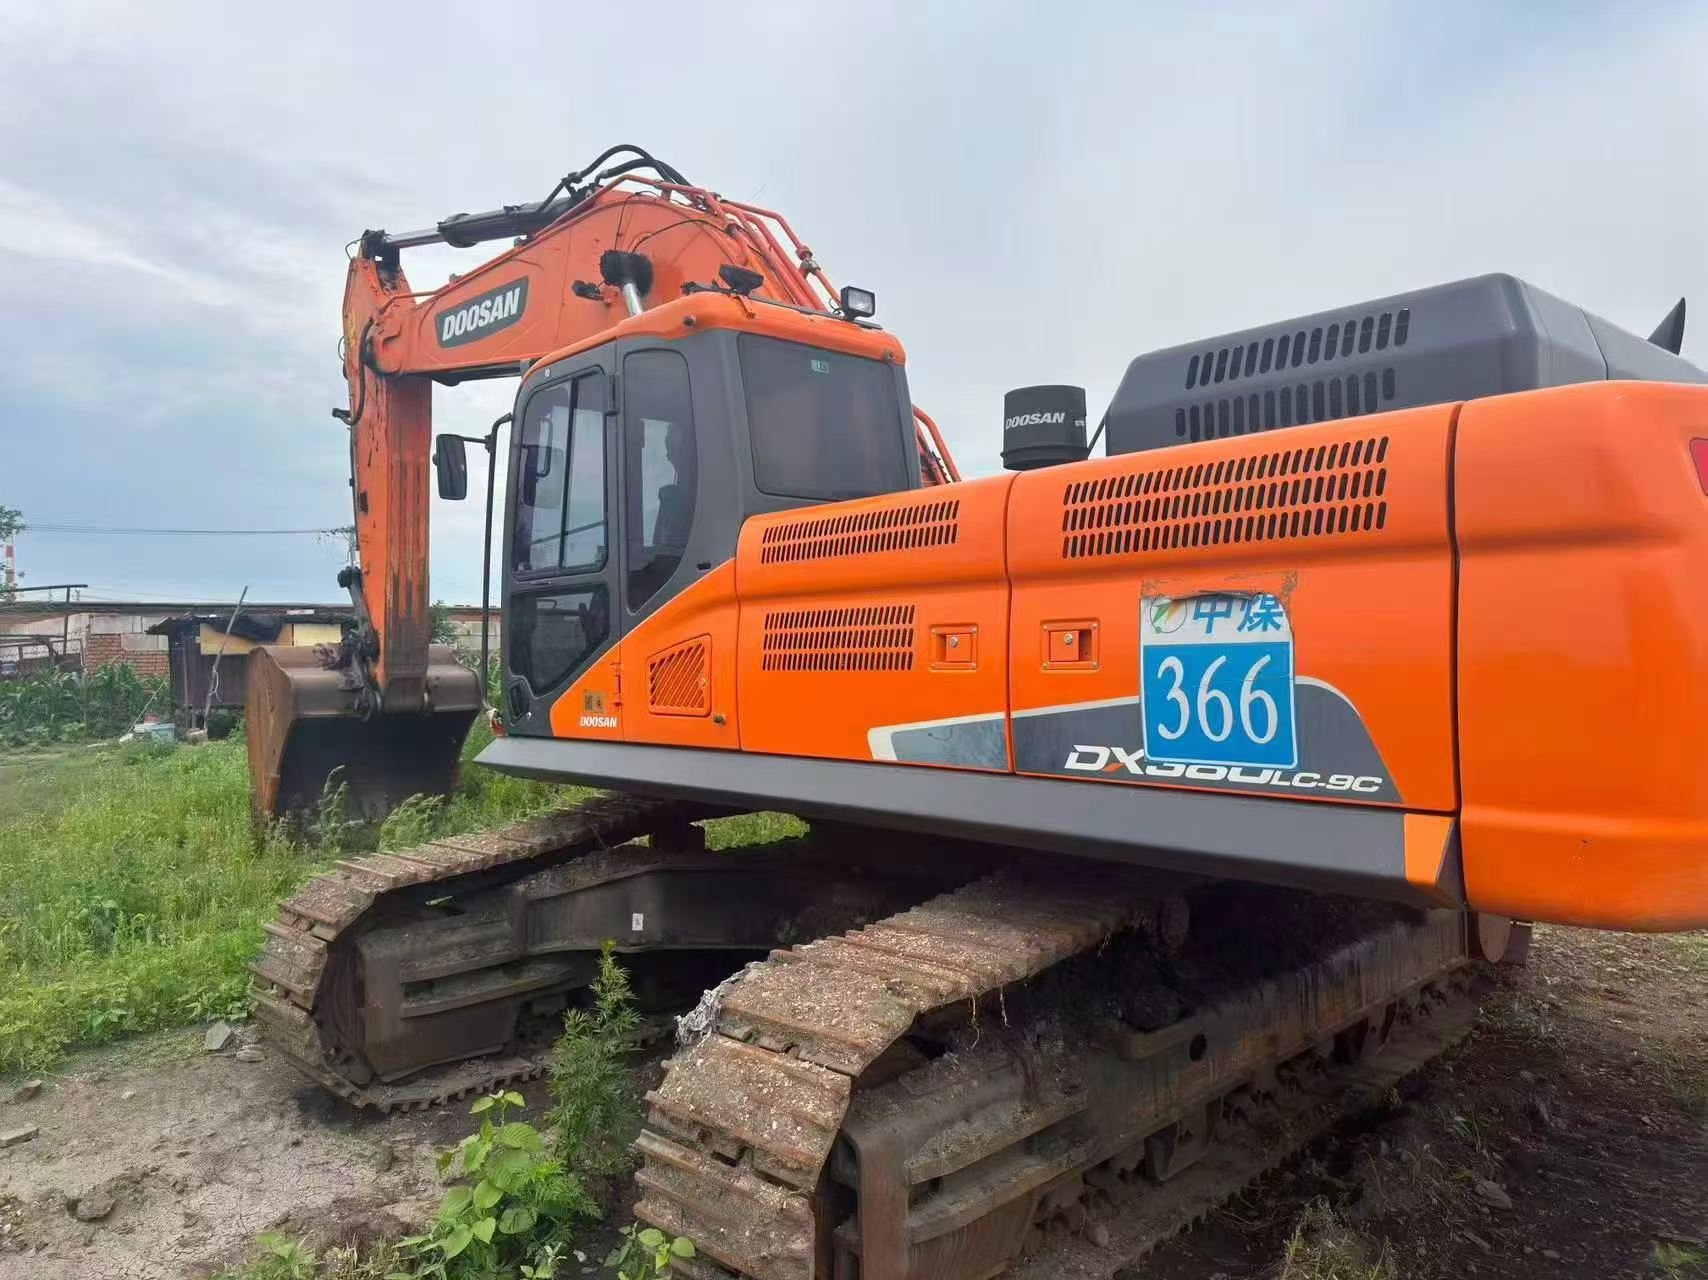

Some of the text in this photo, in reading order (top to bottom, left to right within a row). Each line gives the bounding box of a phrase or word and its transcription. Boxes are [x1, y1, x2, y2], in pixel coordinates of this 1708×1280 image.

[442, 287, 520, 341] DOOSAN
[1005, 412, 1065, 430] DOOSAN
[1157, 653, 1279, 744] 366
[580, 716, 617, 728] DOOSAN
